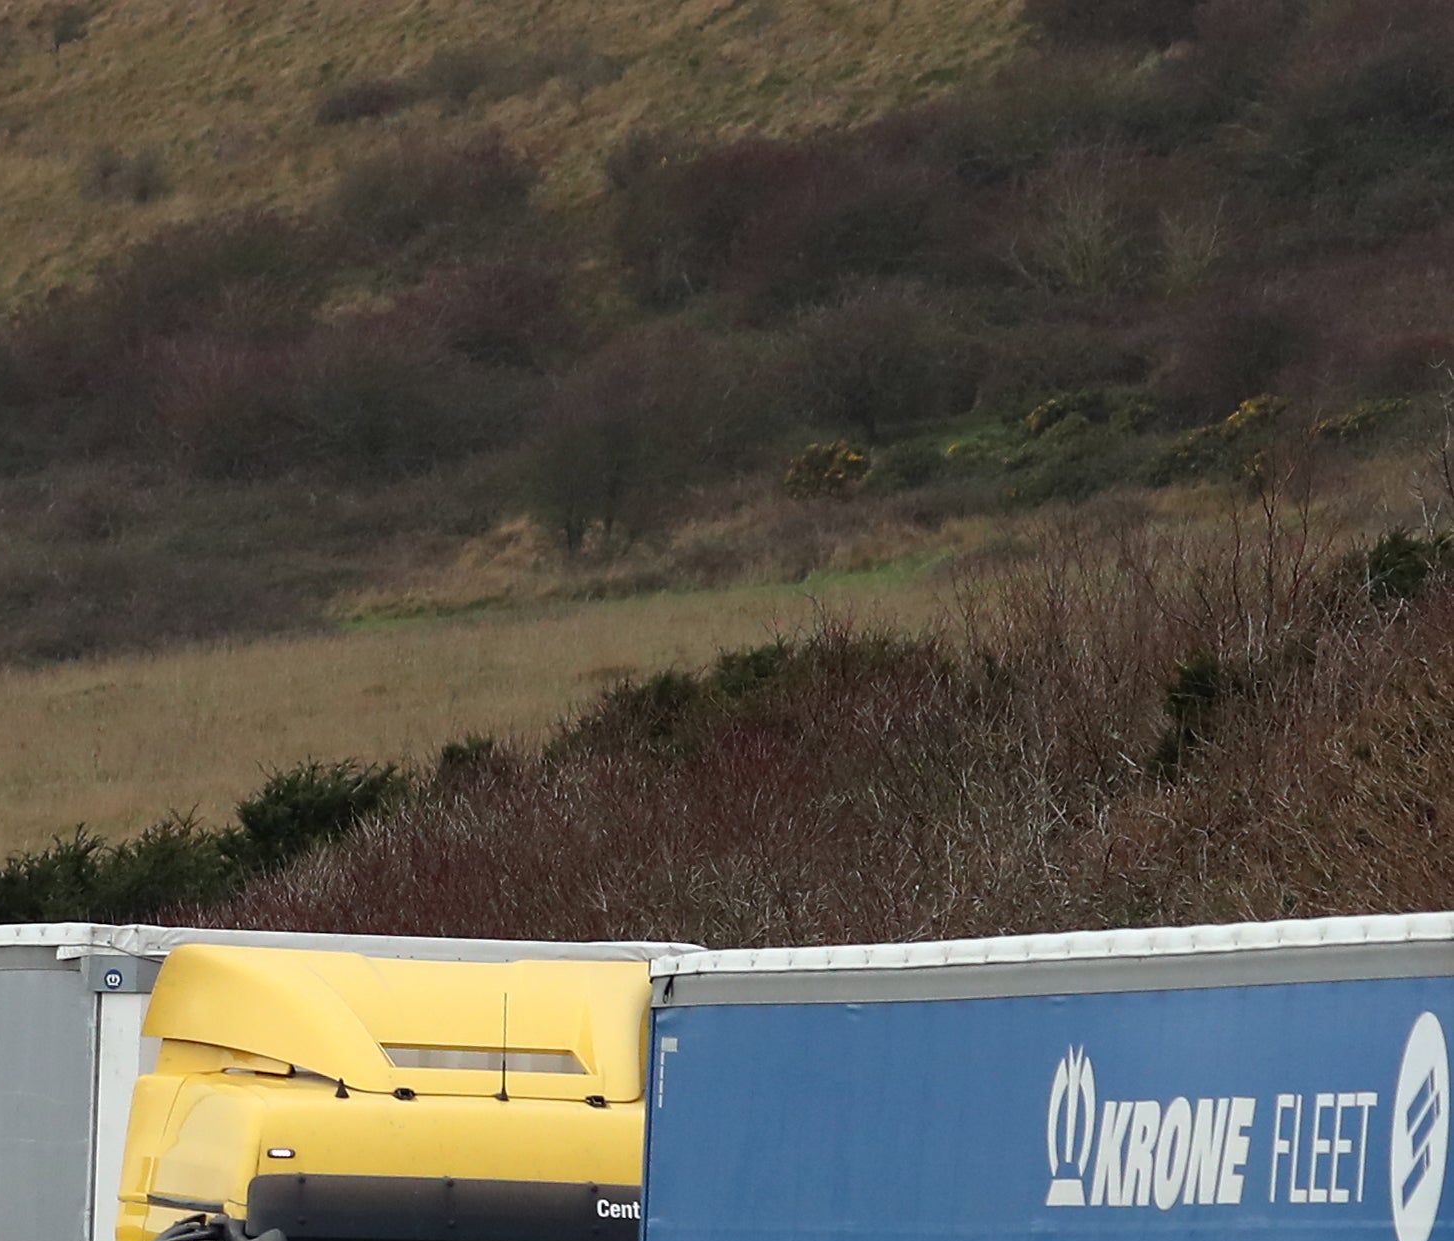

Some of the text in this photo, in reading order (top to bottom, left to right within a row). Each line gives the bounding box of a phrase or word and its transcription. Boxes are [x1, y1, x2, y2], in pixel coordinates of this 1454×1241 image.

[1090, 1092, 1378, 1211] KRONE FLEET
[597, 1199, 641, 1219] Cent
